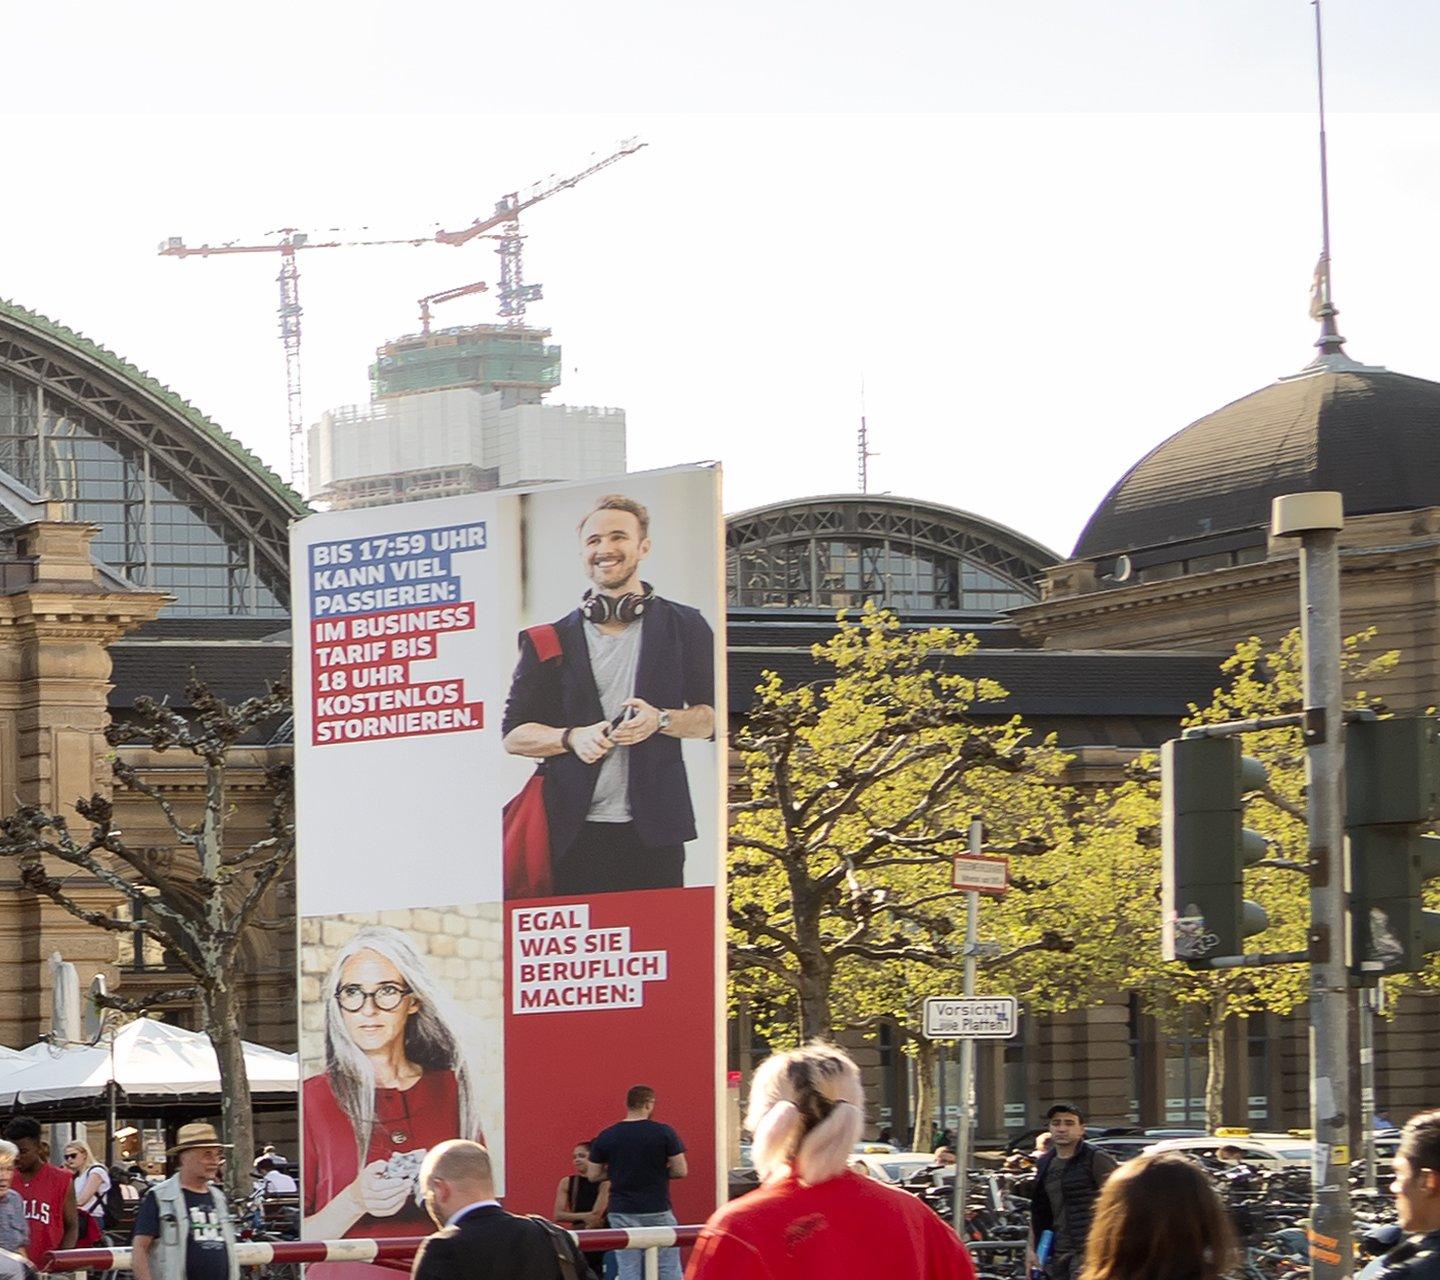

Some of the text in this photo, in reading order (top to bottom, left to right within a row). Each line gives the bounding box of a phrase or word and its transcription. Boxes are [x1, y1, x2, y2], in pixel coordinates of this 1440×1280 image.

[313, 527, 485, 567] BIS 17:59 UHR
[314, 558, 448, 592] KANN VIEL
[315, 581, 457, 616] PASSIEREN:
[316, 606, 470, 643] IM BUSINESS
[315, 637, 432, 667] TARIF BIS
[317, 664, 404, 692] 18 UHR
[317, 683, 458, 717] KOSTENLOS
[316, 707, 479, 742] STORNIEREN.
[518, 910, 582, 932] EGAL
[519, 933, 622, 957] WAS SIE
[520, 956, 658, 983] BERUFLICH
[520, 984, 635, 1008] MACHEN:
[936, 1003, 1005, 1016] Vorsicht!
